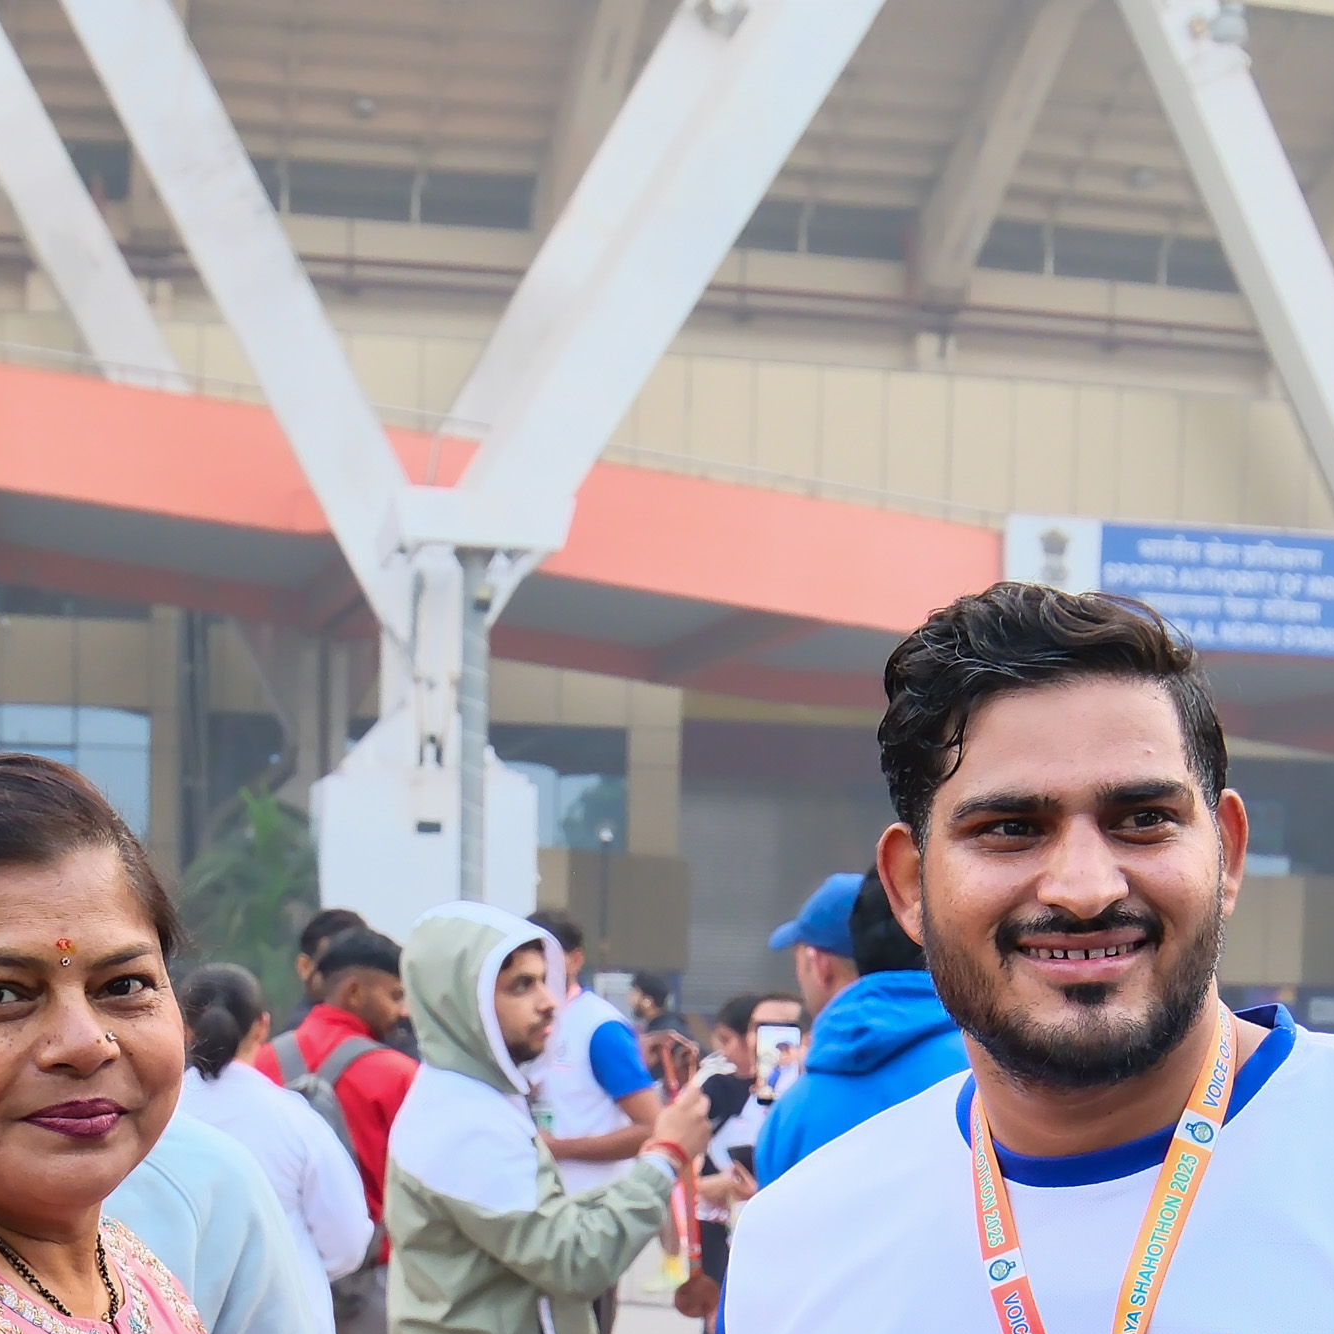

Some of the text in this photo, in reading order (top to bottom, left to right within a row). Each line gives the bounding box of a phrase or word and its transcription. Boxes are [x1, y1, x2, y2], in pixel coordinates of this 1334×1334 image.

[1203, 1057, 1228, 1108] VOICE
[1218, 1037, 1232, 1060] OF
[984, 1208, 1005, 1249] 2025
[1130, 1194, 1184, 1307] SHAHOTHON
[1170, 1152, 1198, 1194] 2025
